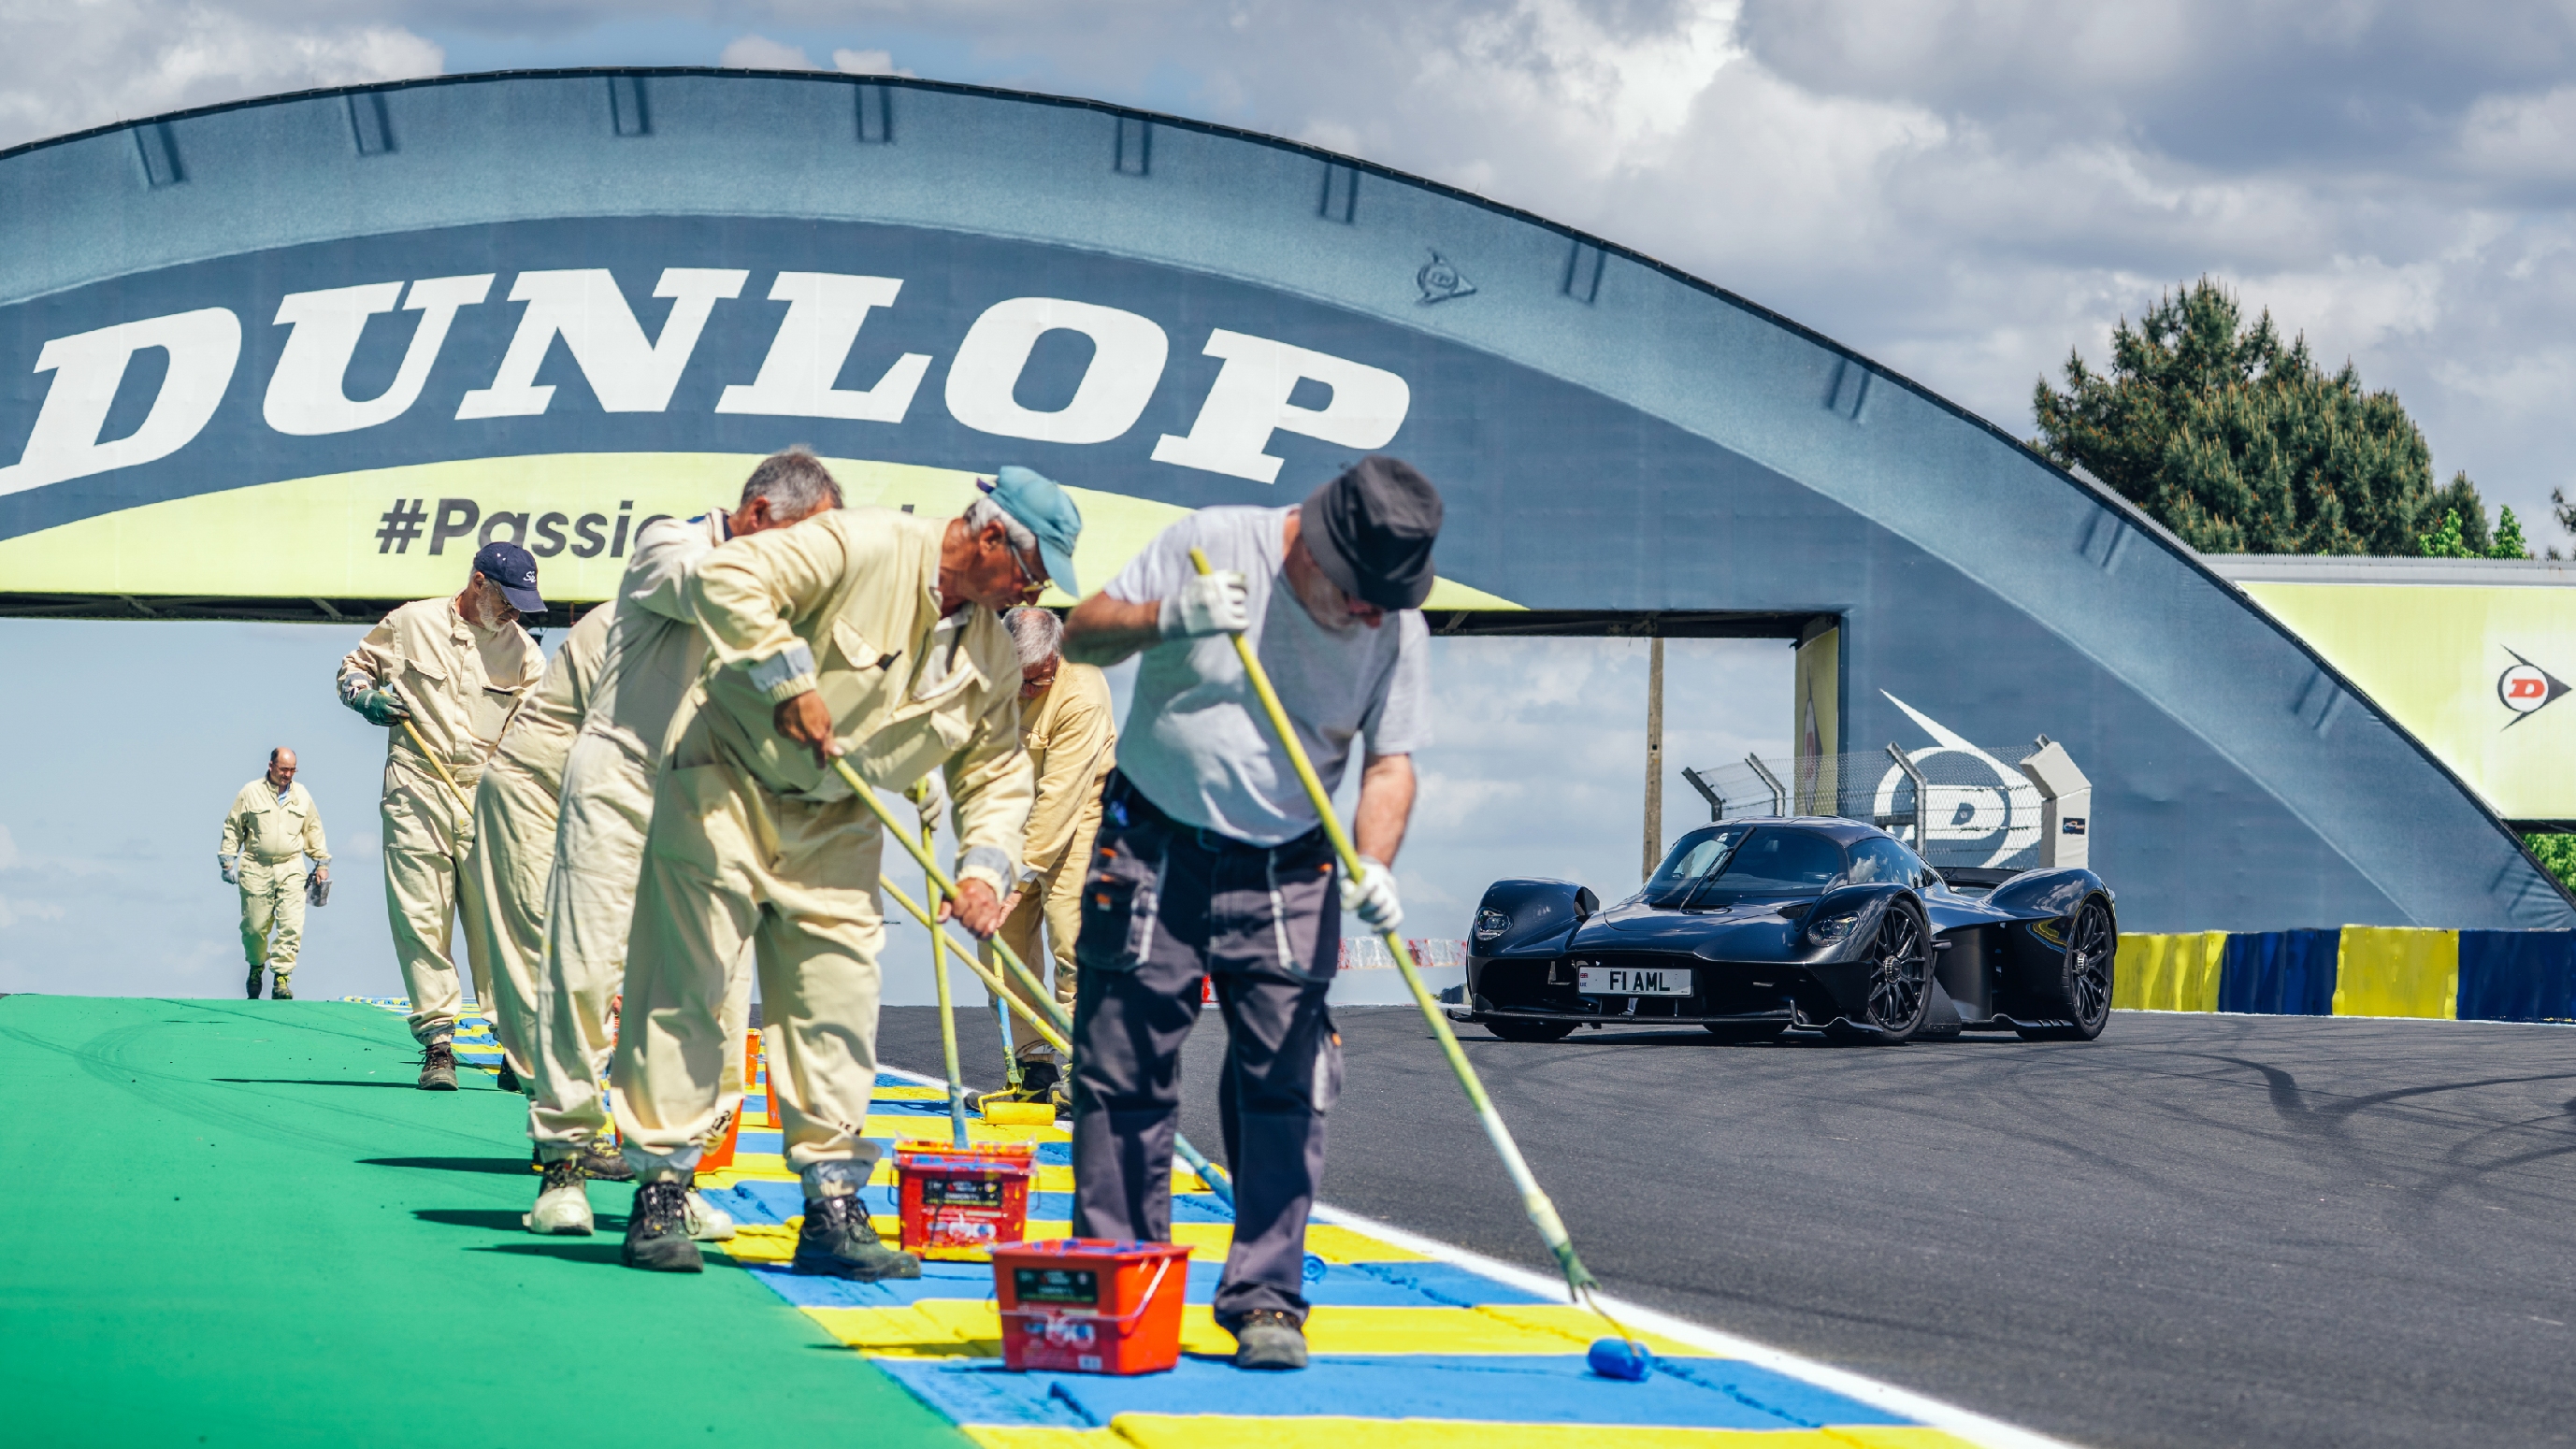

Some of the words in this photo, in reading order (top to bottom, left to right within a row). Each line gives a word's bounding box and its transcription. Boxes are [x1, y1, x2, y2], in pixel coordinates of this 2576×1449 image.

[0, 267, 1410, 495] DUNLOP
[2508, 679, 2545, 698] D
[1633, 972, 1671, 992] AML
